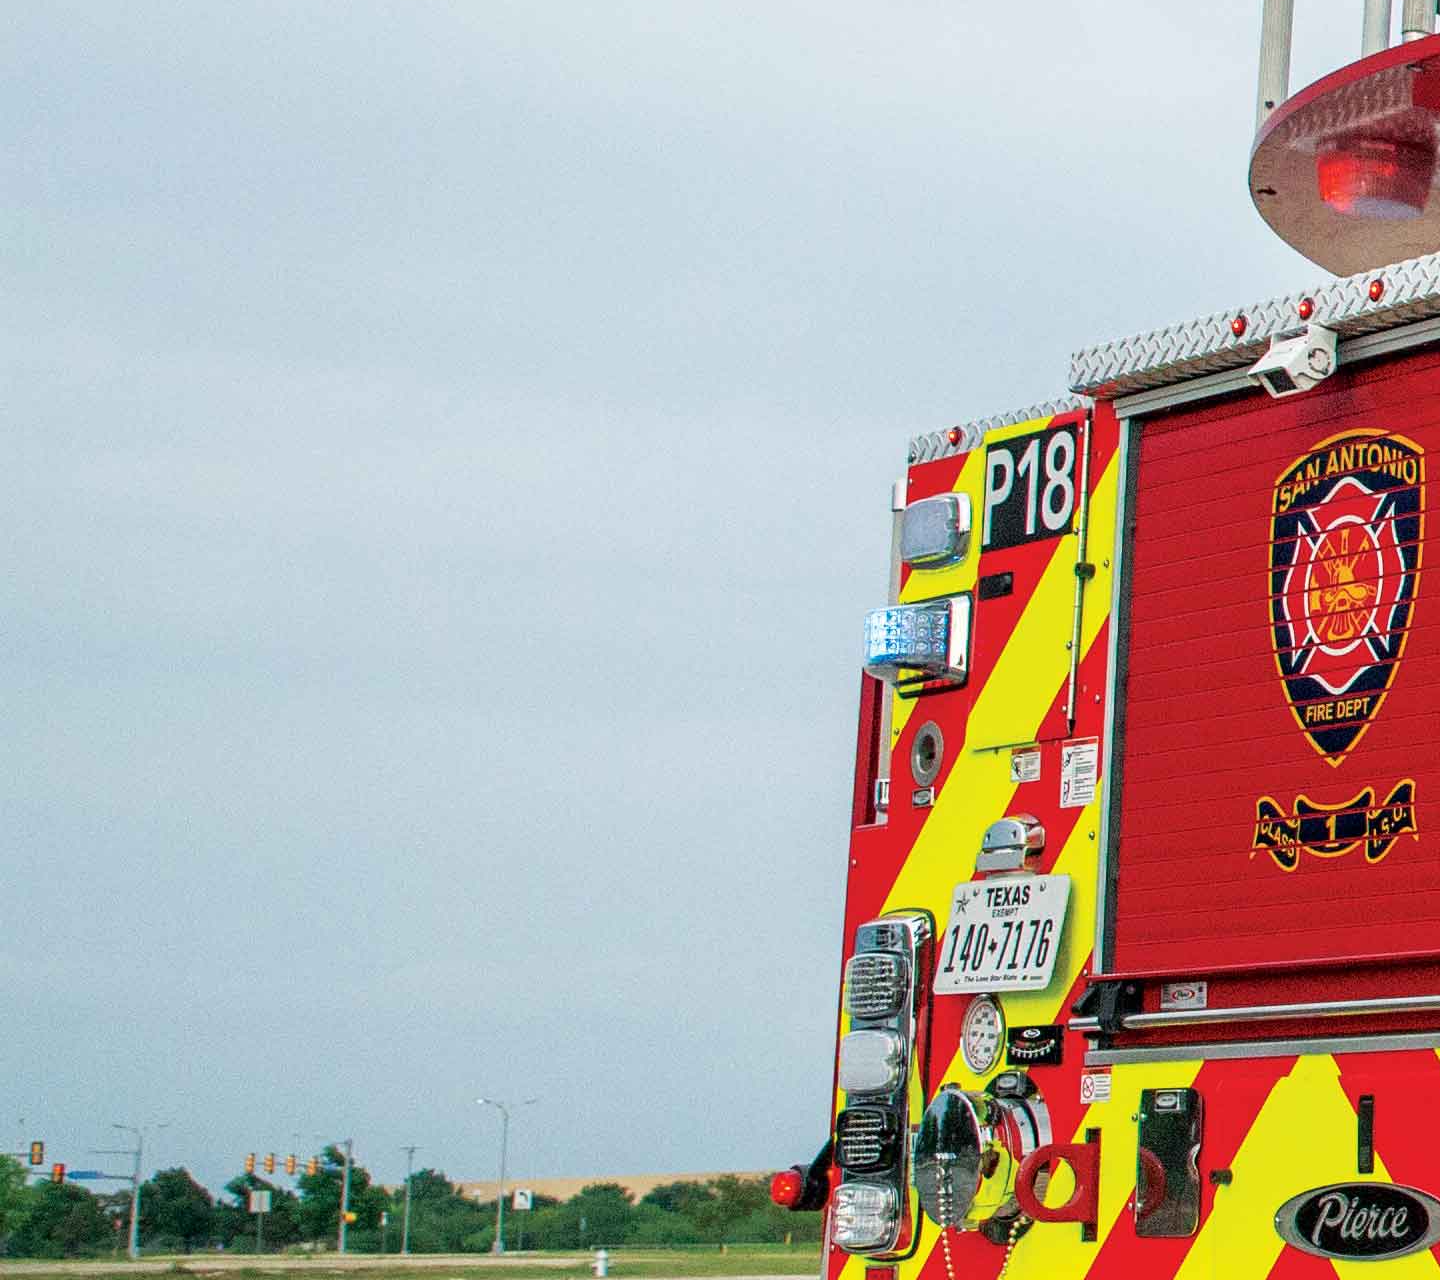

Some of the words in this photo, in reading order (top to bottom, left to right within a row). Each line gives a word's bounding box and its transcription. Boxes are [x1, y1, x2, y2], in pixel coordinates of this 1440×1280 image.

[983, 431, 1075, 546] P18
[1279, 457, 1321, 513] SAN
[1326, 443, 1417, 484] ANTONIO
[1306, 702, 1334, 723] FIRE
[1337, 697, 1371, 719] DEPT
[1260, 815, 1295, 858] CLASS
[1325, 815, 1339, 848] 1
[986, 885, 1031, 908] TEXAS
[992, 907, 1019, 918] EXEMPT
[1312, 1192, 1409, 1246] Pierce
